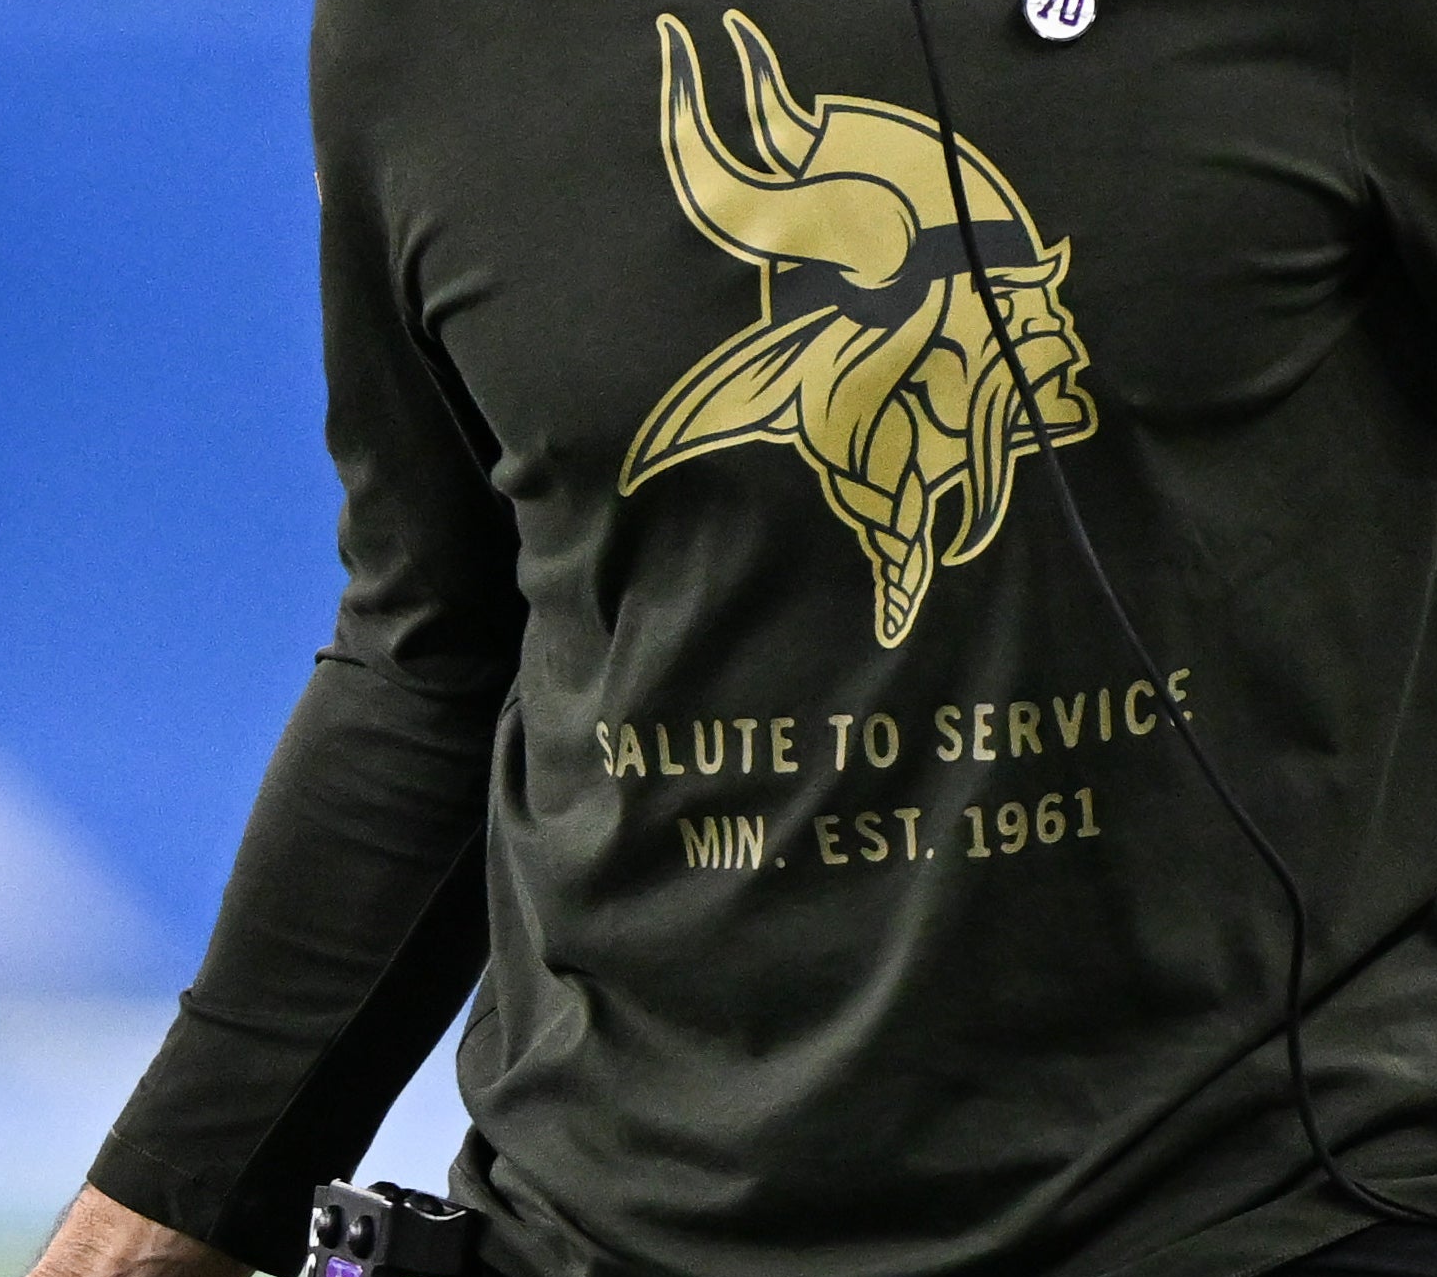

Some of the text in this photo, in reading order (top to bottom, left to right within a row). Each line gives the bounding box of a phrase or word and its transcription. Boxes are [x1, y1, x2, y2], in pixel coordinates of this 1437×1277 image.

[595, 716, 799, 779] SALUTE
[827, 712, 900, 772] TO
[679, 786, 1102, 870] MIN. EST. 1961
